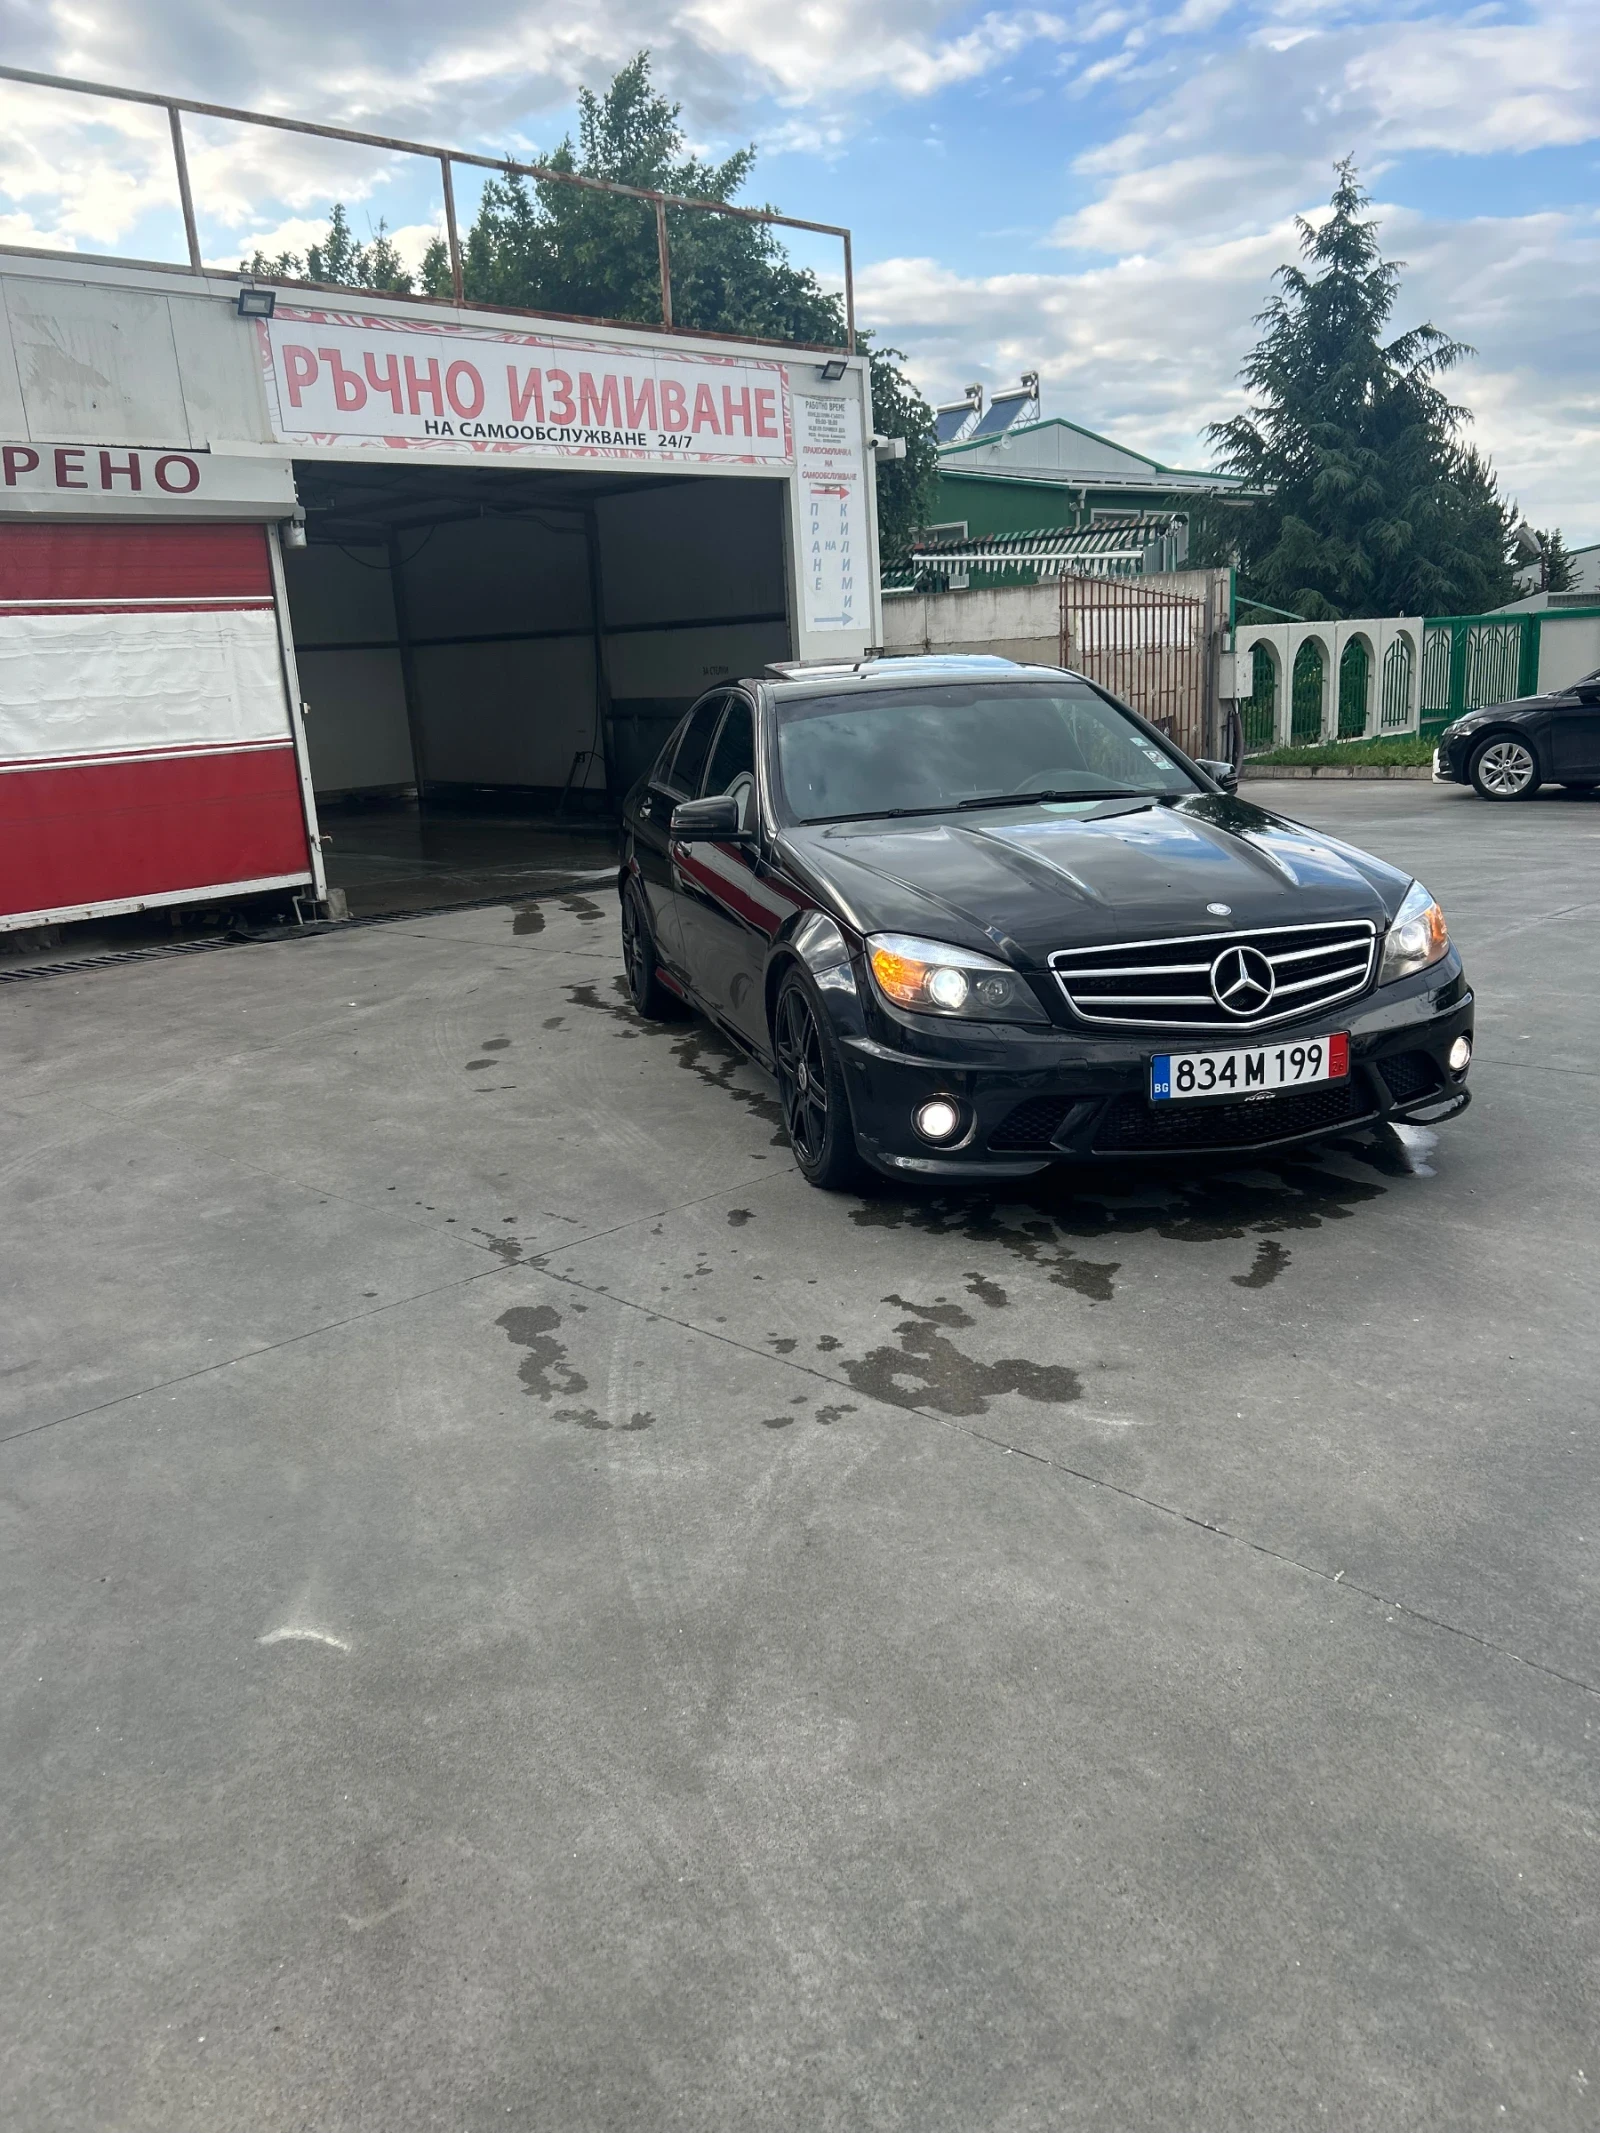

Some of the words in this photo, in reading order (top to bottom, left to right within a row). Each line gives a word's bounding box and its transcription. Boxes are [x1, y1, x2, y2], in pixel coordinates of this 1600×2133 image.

[282, 344, 485, 420] РЪЧНО
[506, 364, 779, 439] ИЗМИВАНЕ
[829, 402, 846, 412] ВРЕМЕ
[424, 419, 455, 437] НА
[459, 421, 647, 447] САМООБСЛУЖВАНЕ
[658, 434, 693, 449] 24/7
[802, 446, 852, 456] ПРАХОСМУКАЧКА
[2, 446, 201, 494] РЕНО
[801, 470, 857, 481] САМООБСЛУЖВАНЕ
[810, 502, 823, 591] ПРАНЕ
[824, 540, 837, 551] НА
[839, 503, 853, 608] КИЛИМИ
[1154, 1083, 1169, 1093] BG
[1176, 1055, 1238, 1092] 834
[1275, 1044, 1323, 1082] 199
